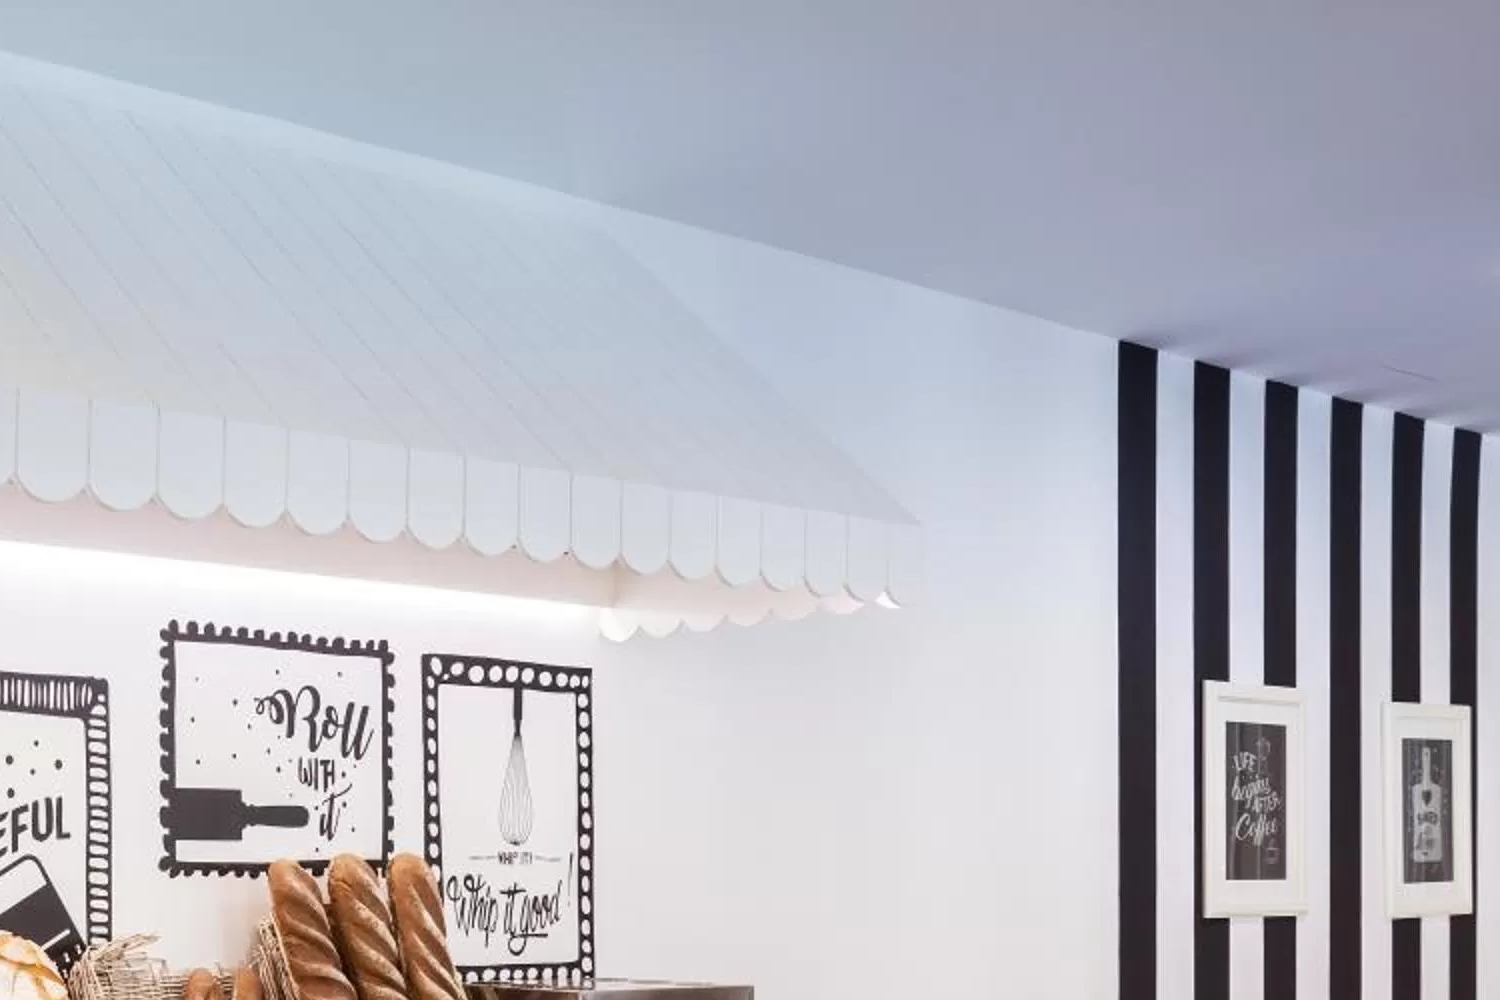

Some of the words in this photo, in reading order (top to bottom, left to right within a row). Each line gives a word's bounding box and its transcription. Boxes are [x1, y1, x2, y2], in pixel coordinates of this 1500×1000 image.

[254, 685, 375, 761] Roll
[297, 757, 336, 793] WITH
[319, 783, 352, 841] it
[446, 873, 499, 949] Whip
